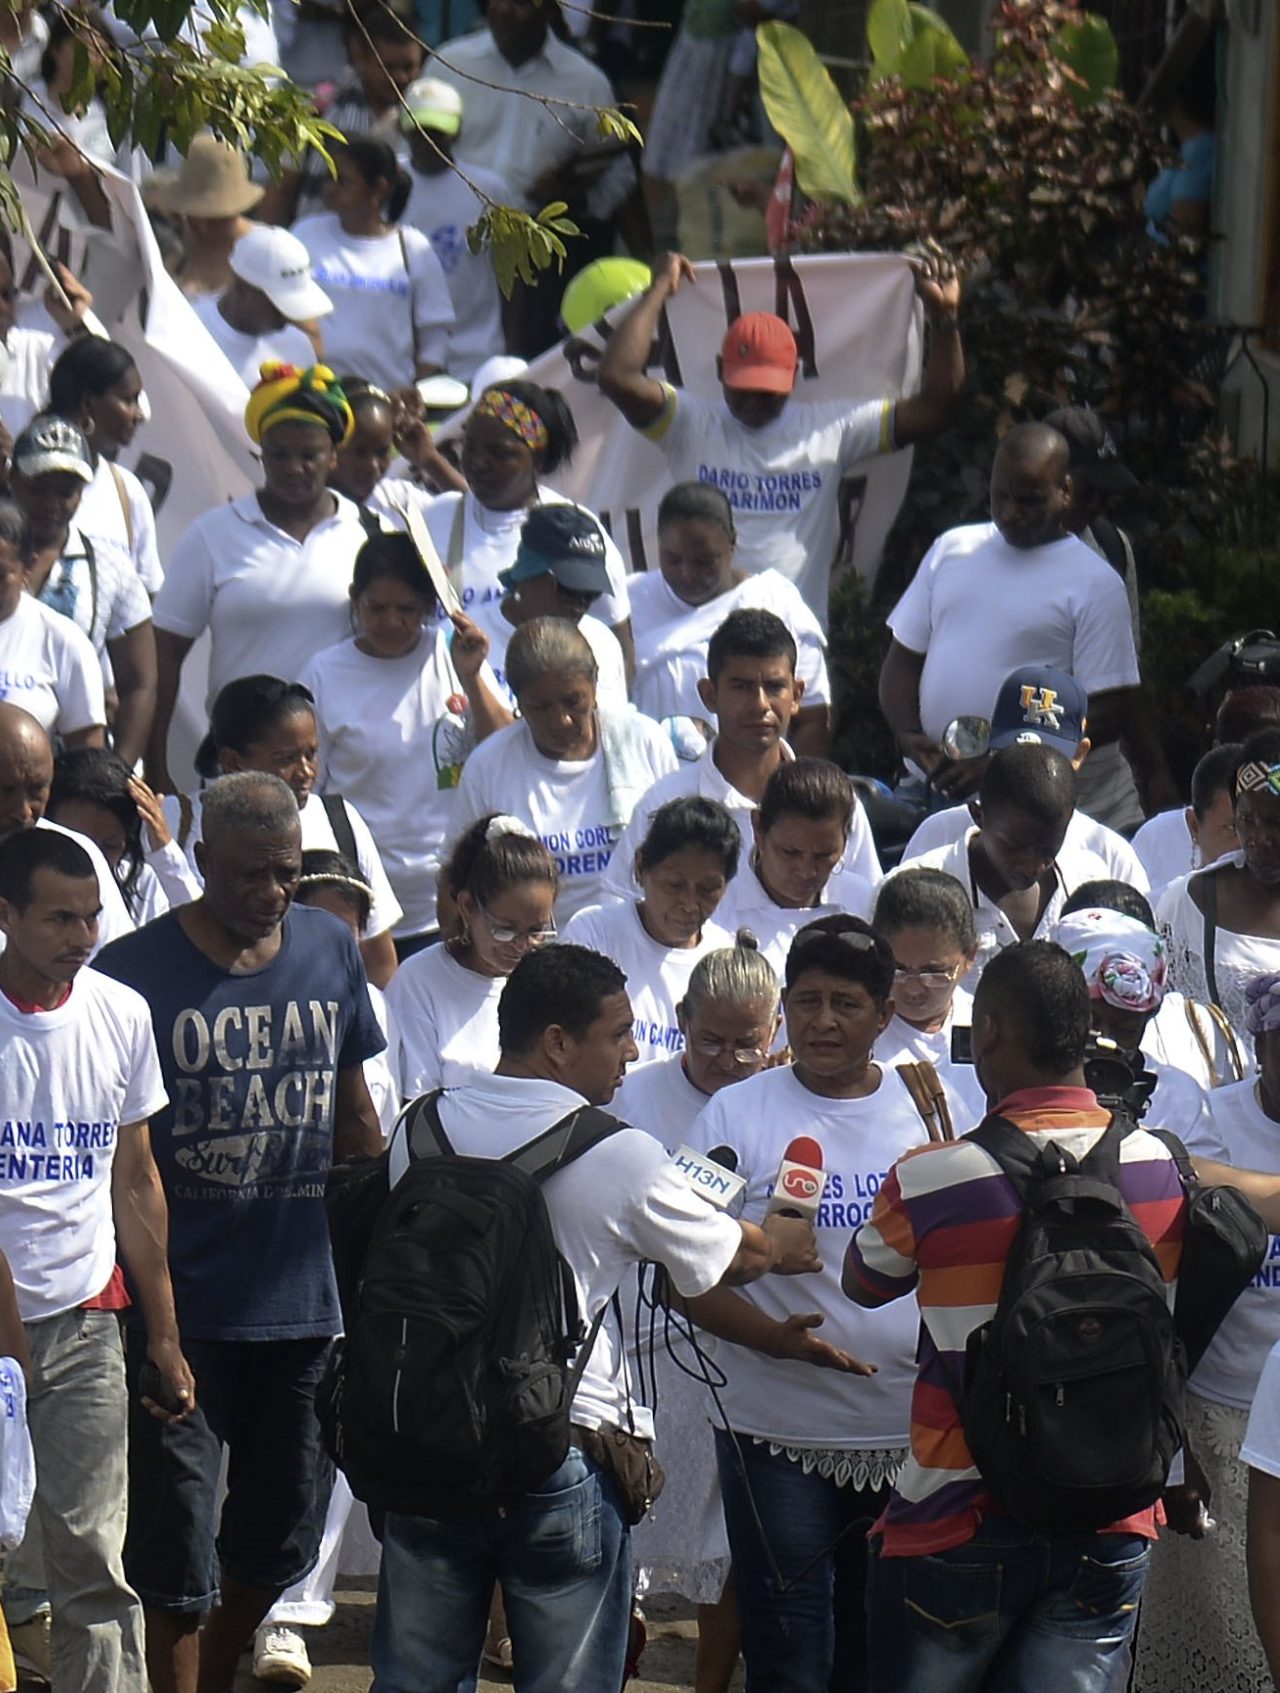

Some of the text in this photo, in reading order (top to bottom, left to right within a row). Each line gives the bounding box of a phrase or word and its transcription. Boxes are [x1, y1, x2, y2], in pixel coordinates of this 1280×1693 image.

[698, 465, 822, 493] DARIO TORRES
[729, 491, 801, 511] ARIMON
[172, 1000, 339, 1073] OCEAN
[172, 1070, 333, 1136] BEACH
[675, 1156, 731, 1195] H13N
